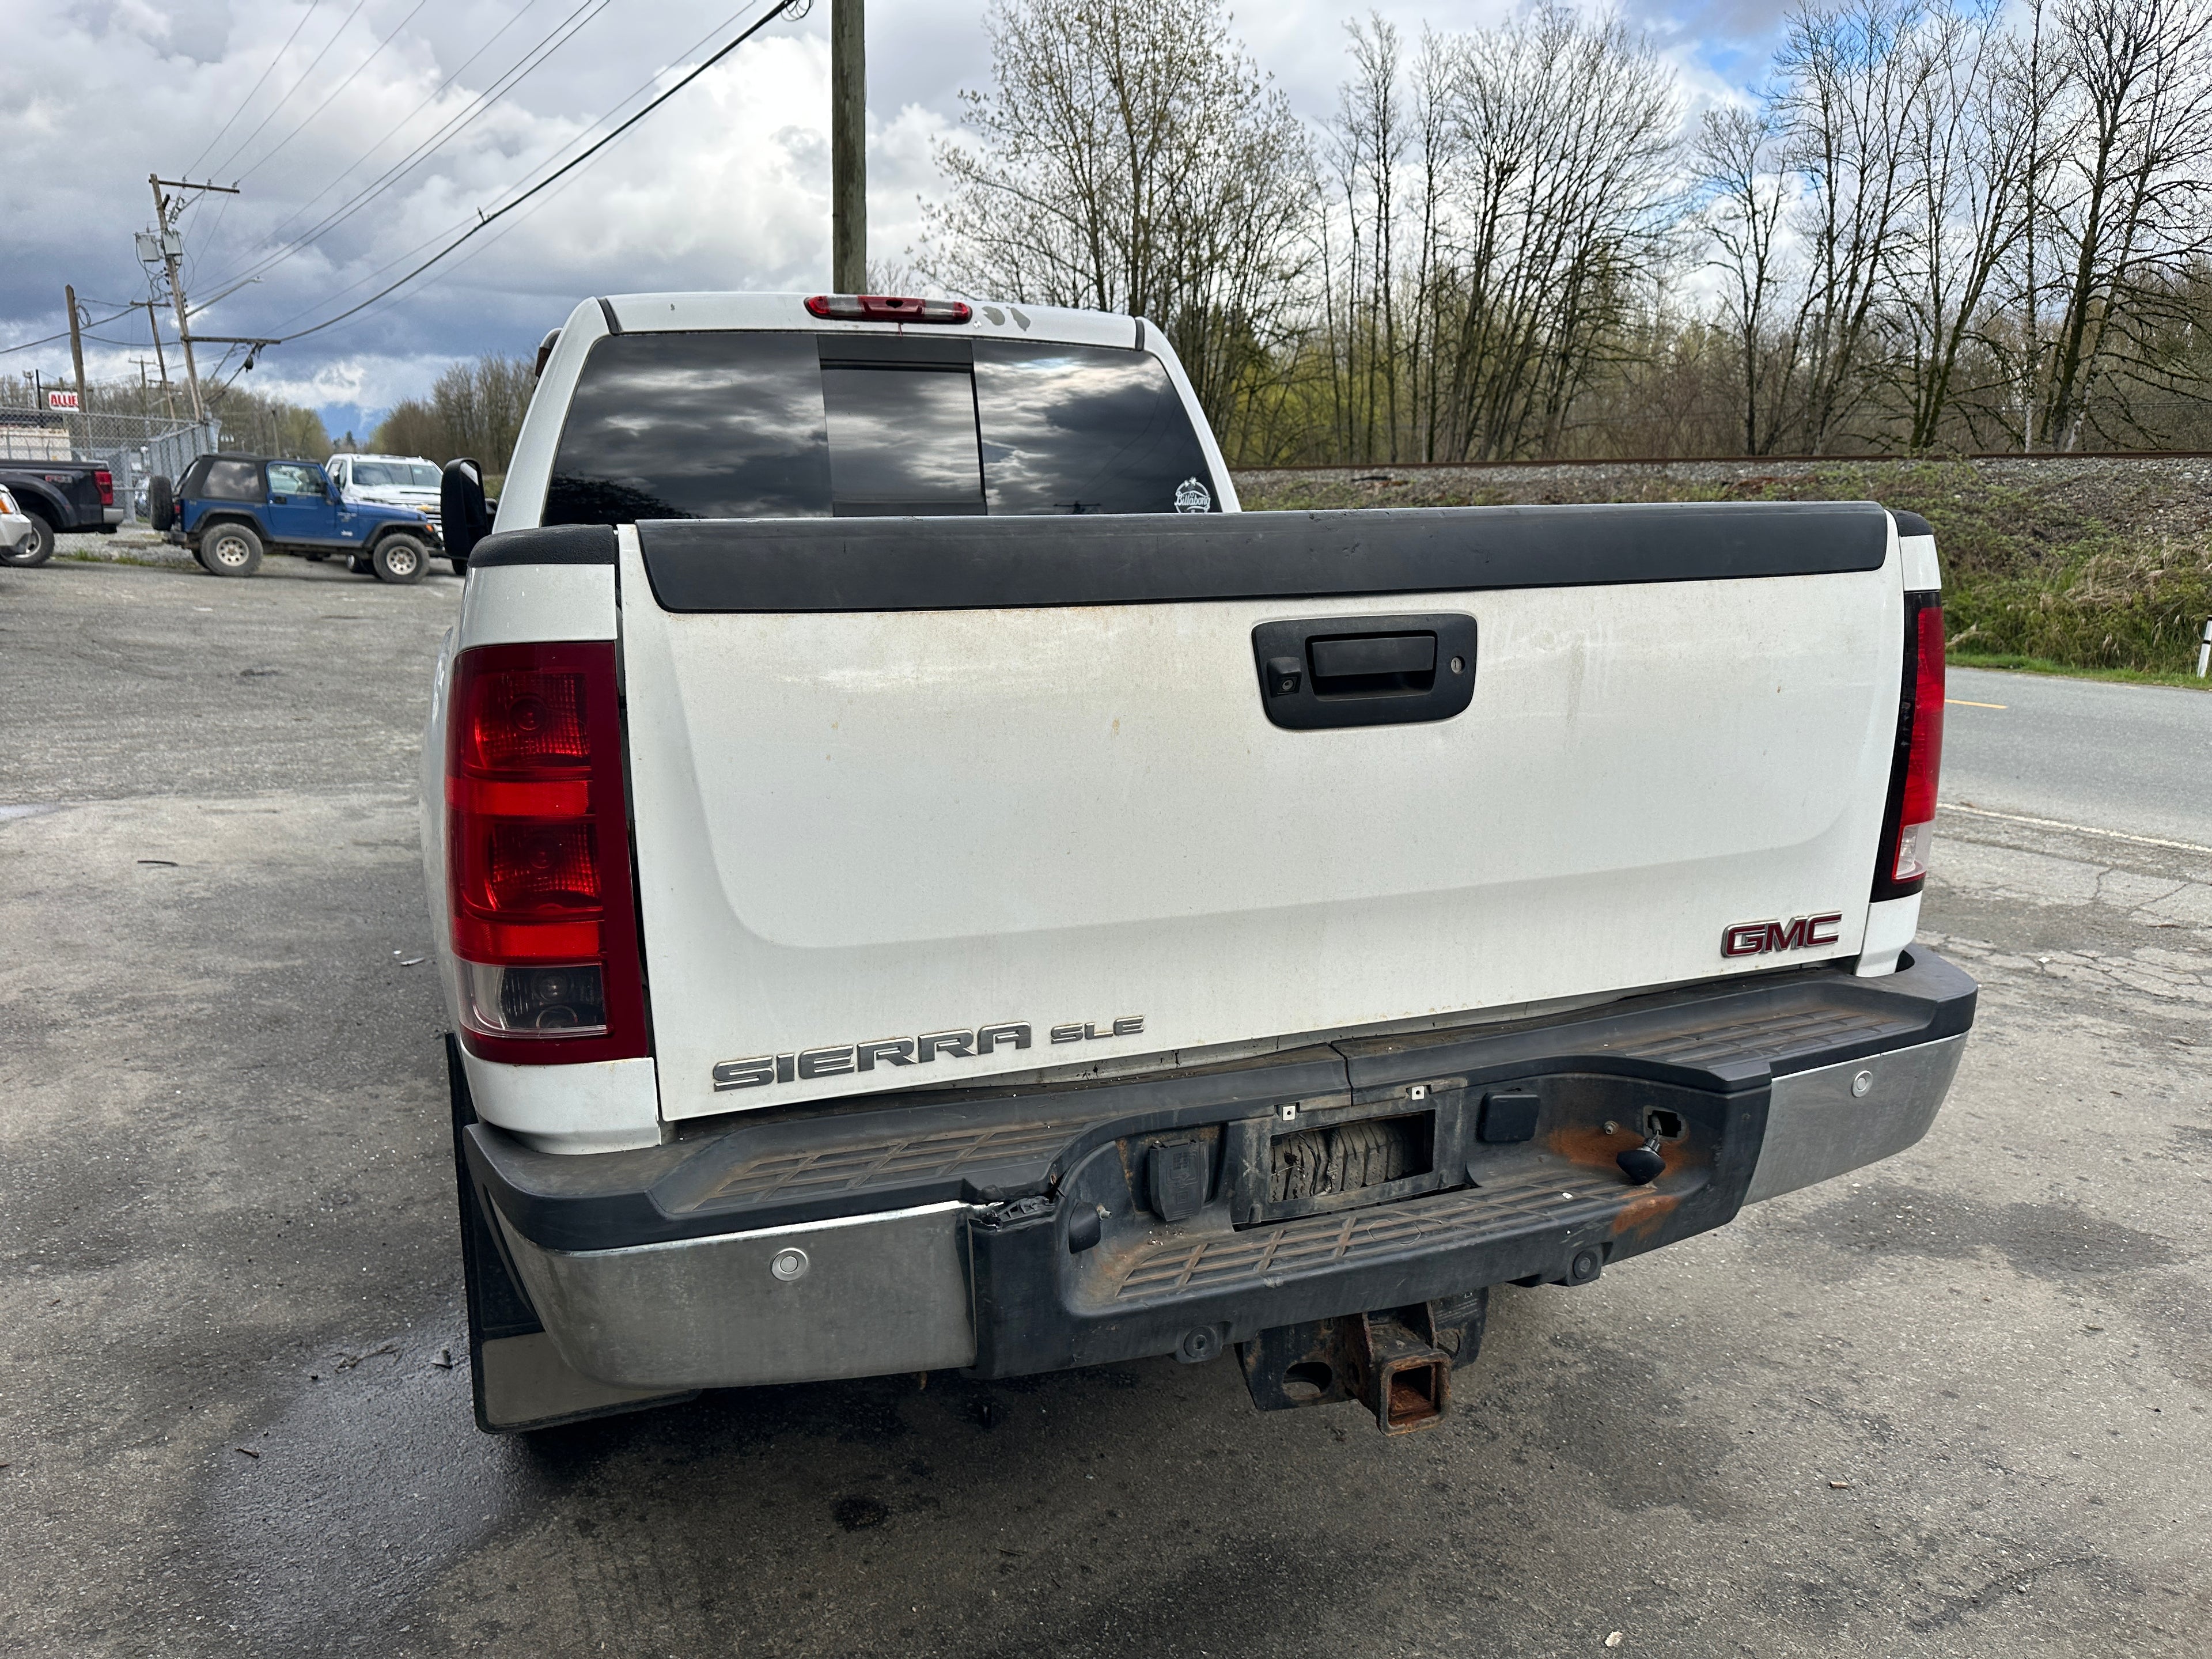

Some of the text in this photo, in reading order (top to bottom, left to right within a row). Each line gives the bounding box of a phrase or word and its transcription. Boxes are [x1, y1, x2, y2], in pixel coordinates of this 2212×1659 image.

[1174, 491, 1211, 512] Billabong
[1721, 911, 1842, 957] GMC
[713, 1015, 1145, 1092] SIERRA SLE
